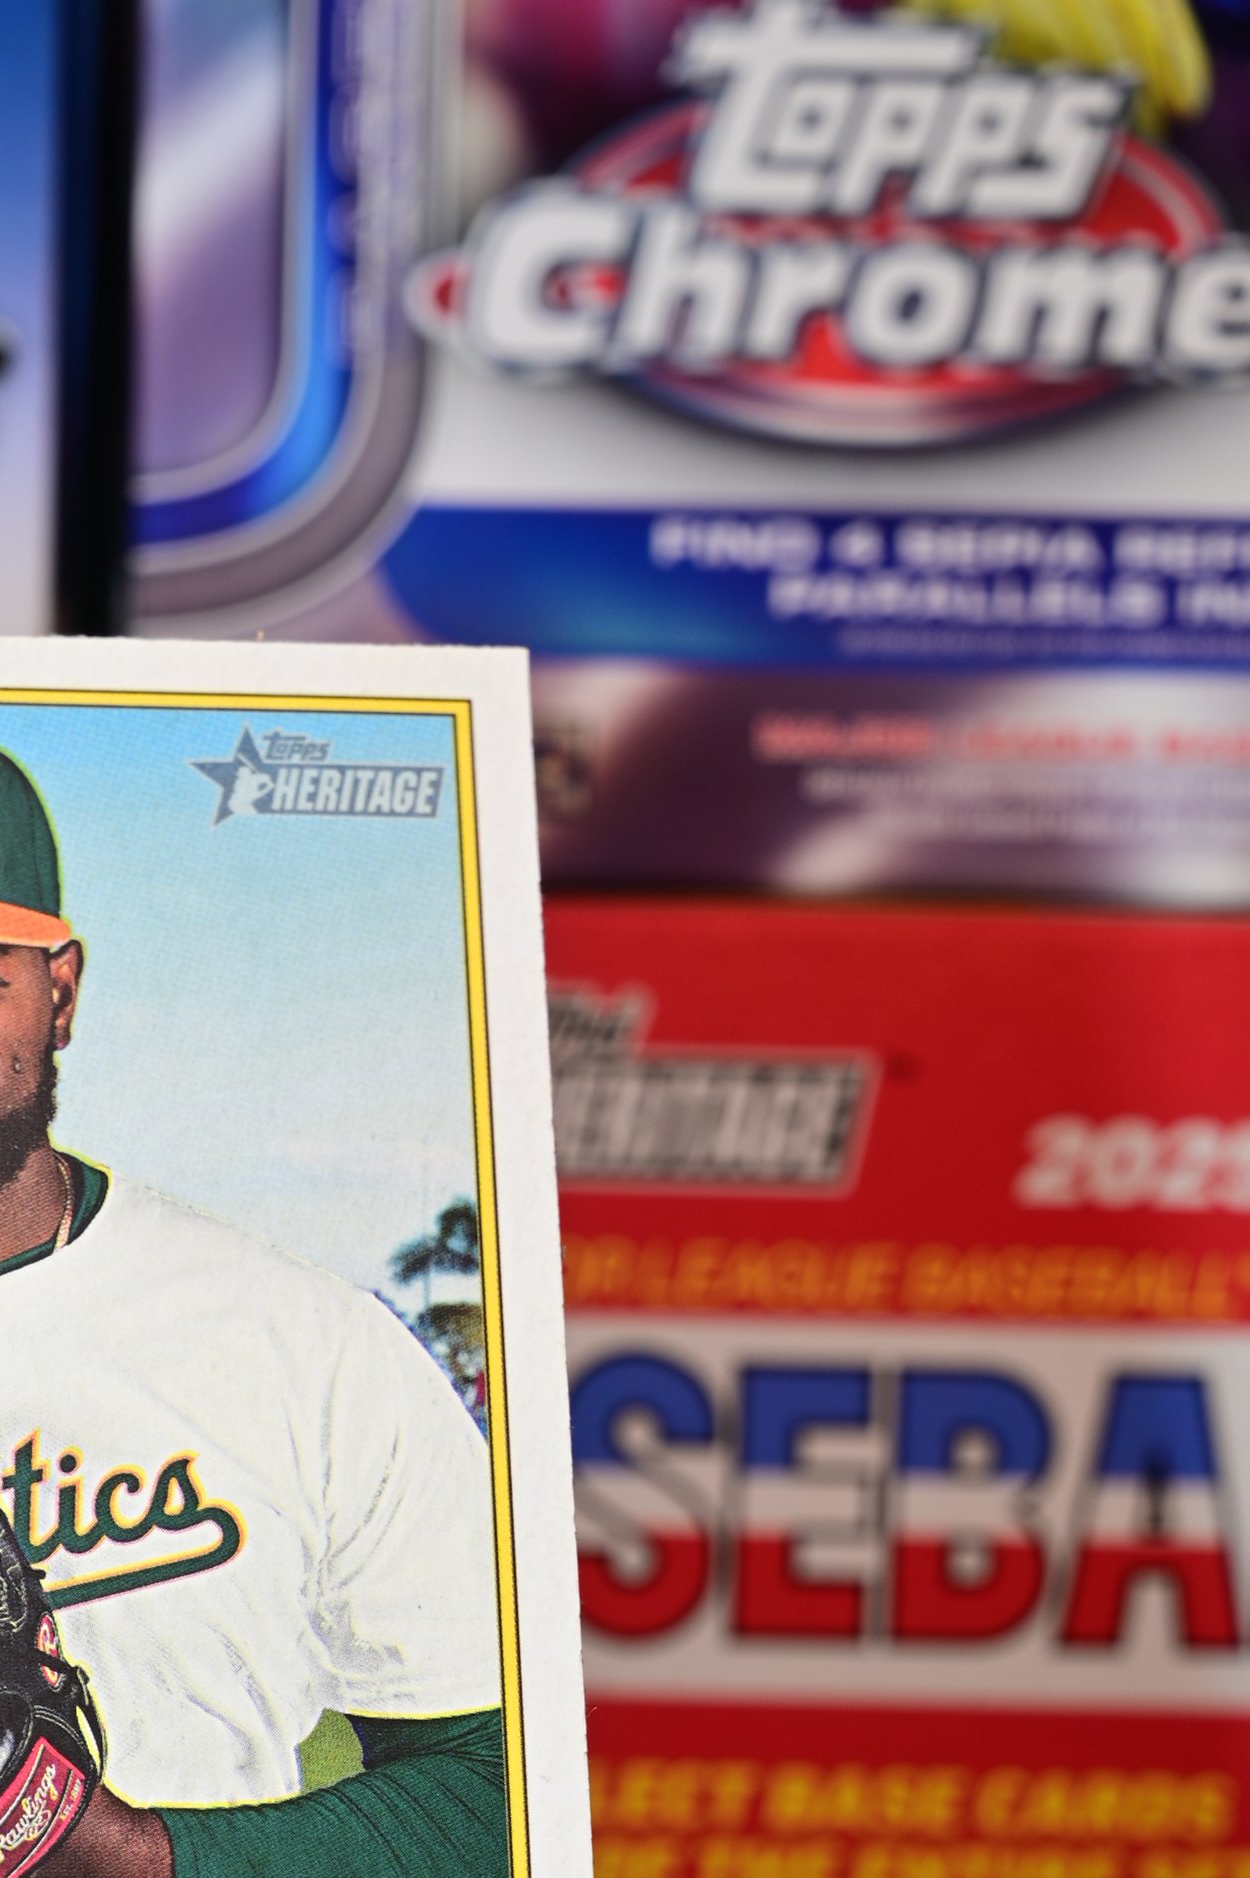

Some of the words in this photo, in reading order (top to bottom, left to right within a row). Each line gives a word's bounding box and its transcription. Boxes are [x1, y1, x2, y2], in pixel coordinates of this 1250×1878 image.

[472, 178, 1250, 375] Chrome
[270, 767, 440, 815] HERITAGE
[568, 1354, 1242, 1652] SEBA
[768, 1766, 966, 1832] BASE
[980, 1772, 1231, 1839] CARDS
